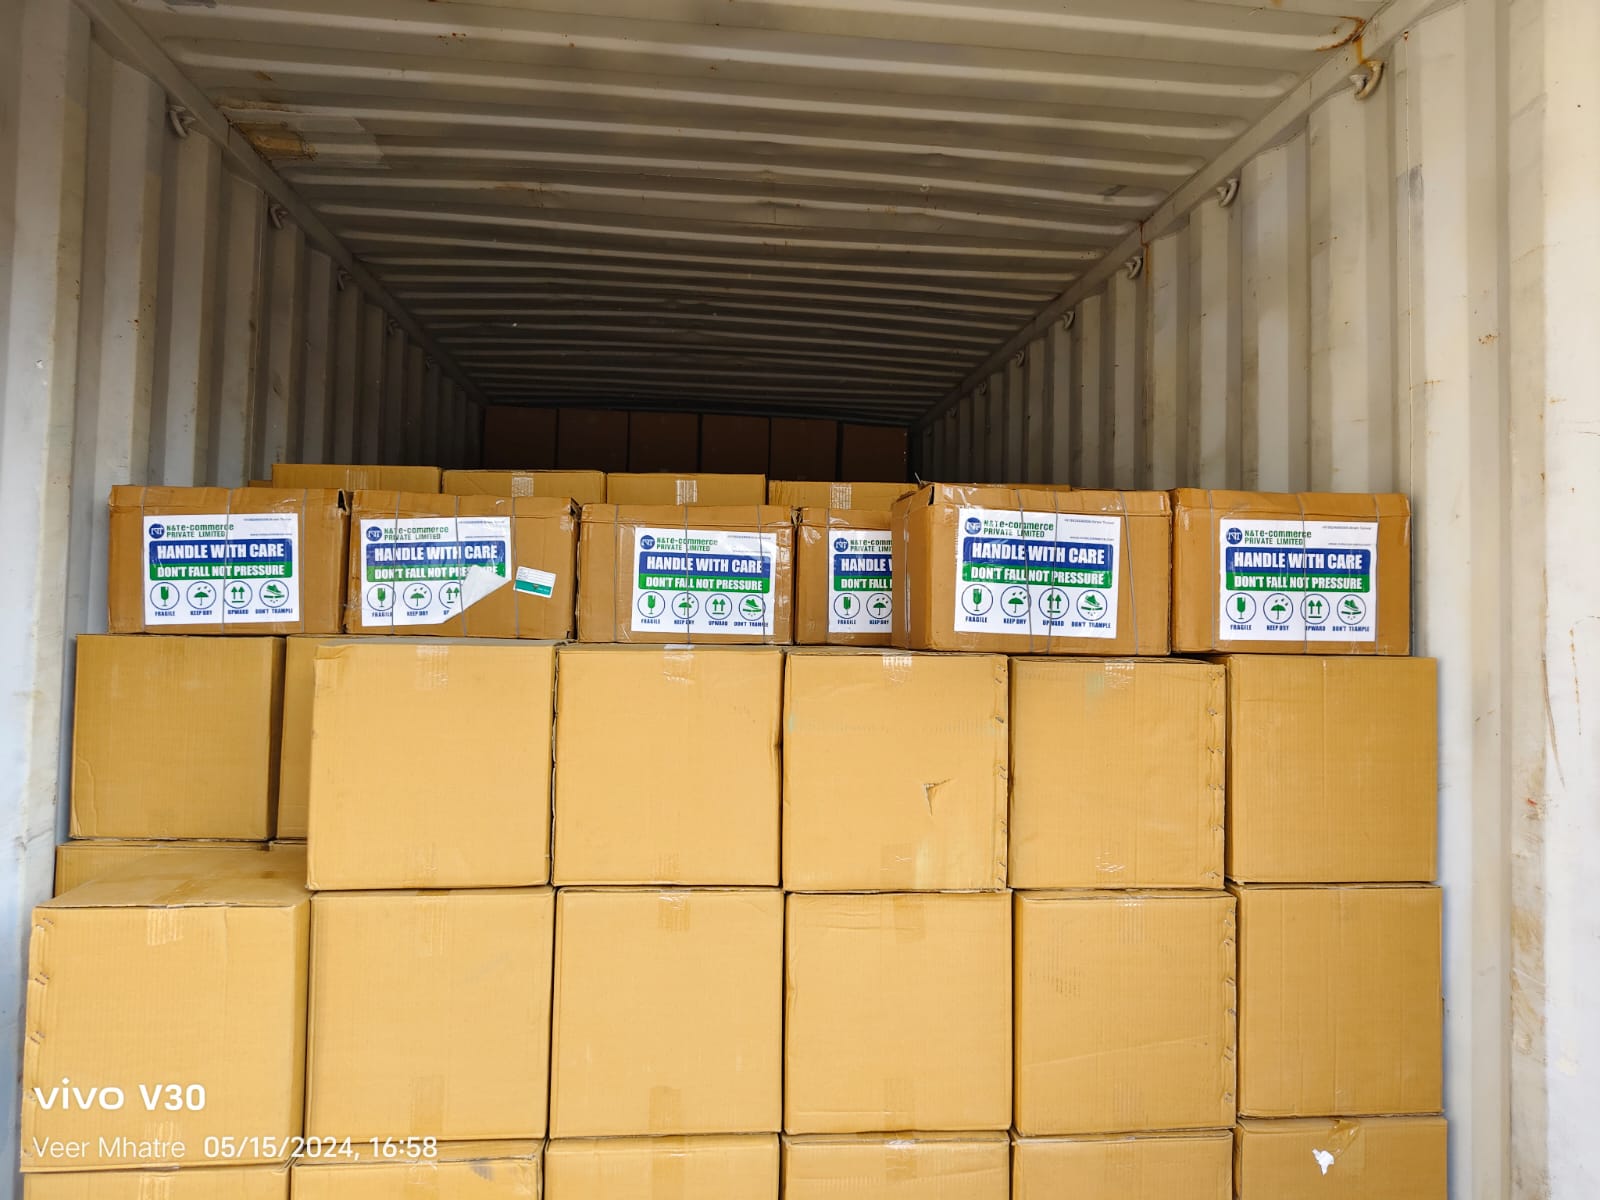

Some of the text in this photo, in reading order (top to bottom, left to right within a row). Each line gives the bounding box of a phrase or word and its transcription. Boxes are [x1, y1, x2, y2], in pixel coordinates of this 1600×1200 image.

[157, 543, 283, 559] HANDLE WITH CARE
[375, 545, 497, 562] HANDLE WITH CARE
[972, 543, 1104, 564] HANDLE WITH CARE
[647, 556, 762, 573] HANDLE WITH CARE
[842, 559, 886, 571] HANDLE
[1235, 552, 1362, 569] HANDLE WITH CARE
[158, 565, 284, 577] DON'T FALL NOT PRESSURE
[375, 568, 403, 579] DON'T
[405, 568, 426, 578] FALL
[430, 567, 447, 577] NOT
[971, 567, 1104, 584] DON'T FALL NOT PRESSURE
[646, 577, 762, 591] DON'T FALL NOT PRESSURE
[841, 579, 867, 588] DON'T
[869, 579, 887, 588] FALL
[1235, 576, 1362, 589] DON'T FALL NOT PRESSURE
